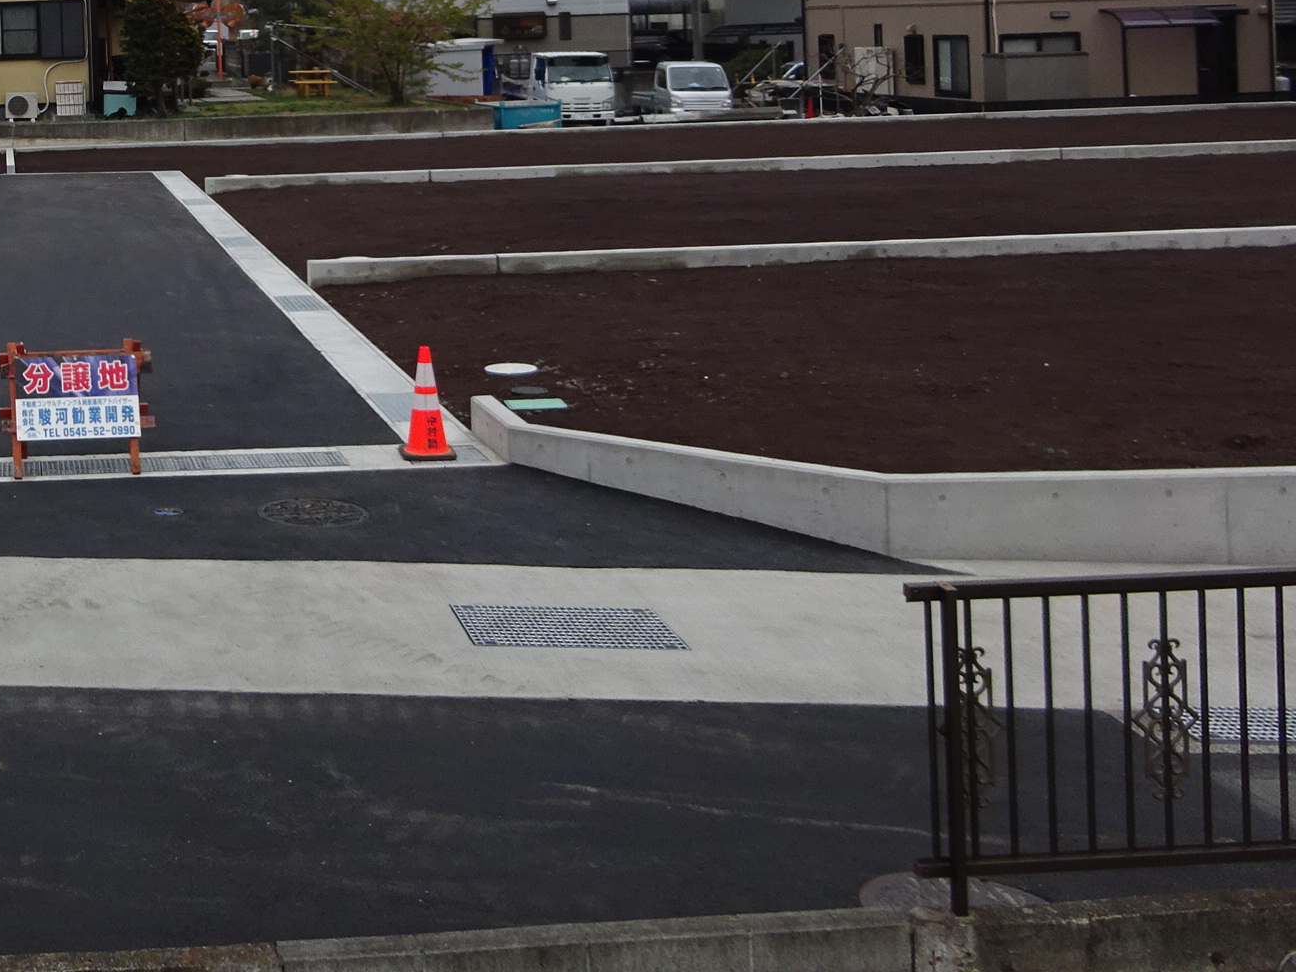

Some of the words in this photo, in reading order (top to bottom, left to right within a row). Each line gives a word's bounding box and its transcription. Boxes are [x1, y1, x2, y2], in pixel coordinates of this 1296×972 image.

[23, 360, 129, 394] 分譲地
[43, 428, 61, 438] TEL
[63, 425, 135, 437] 0545-52-0990
